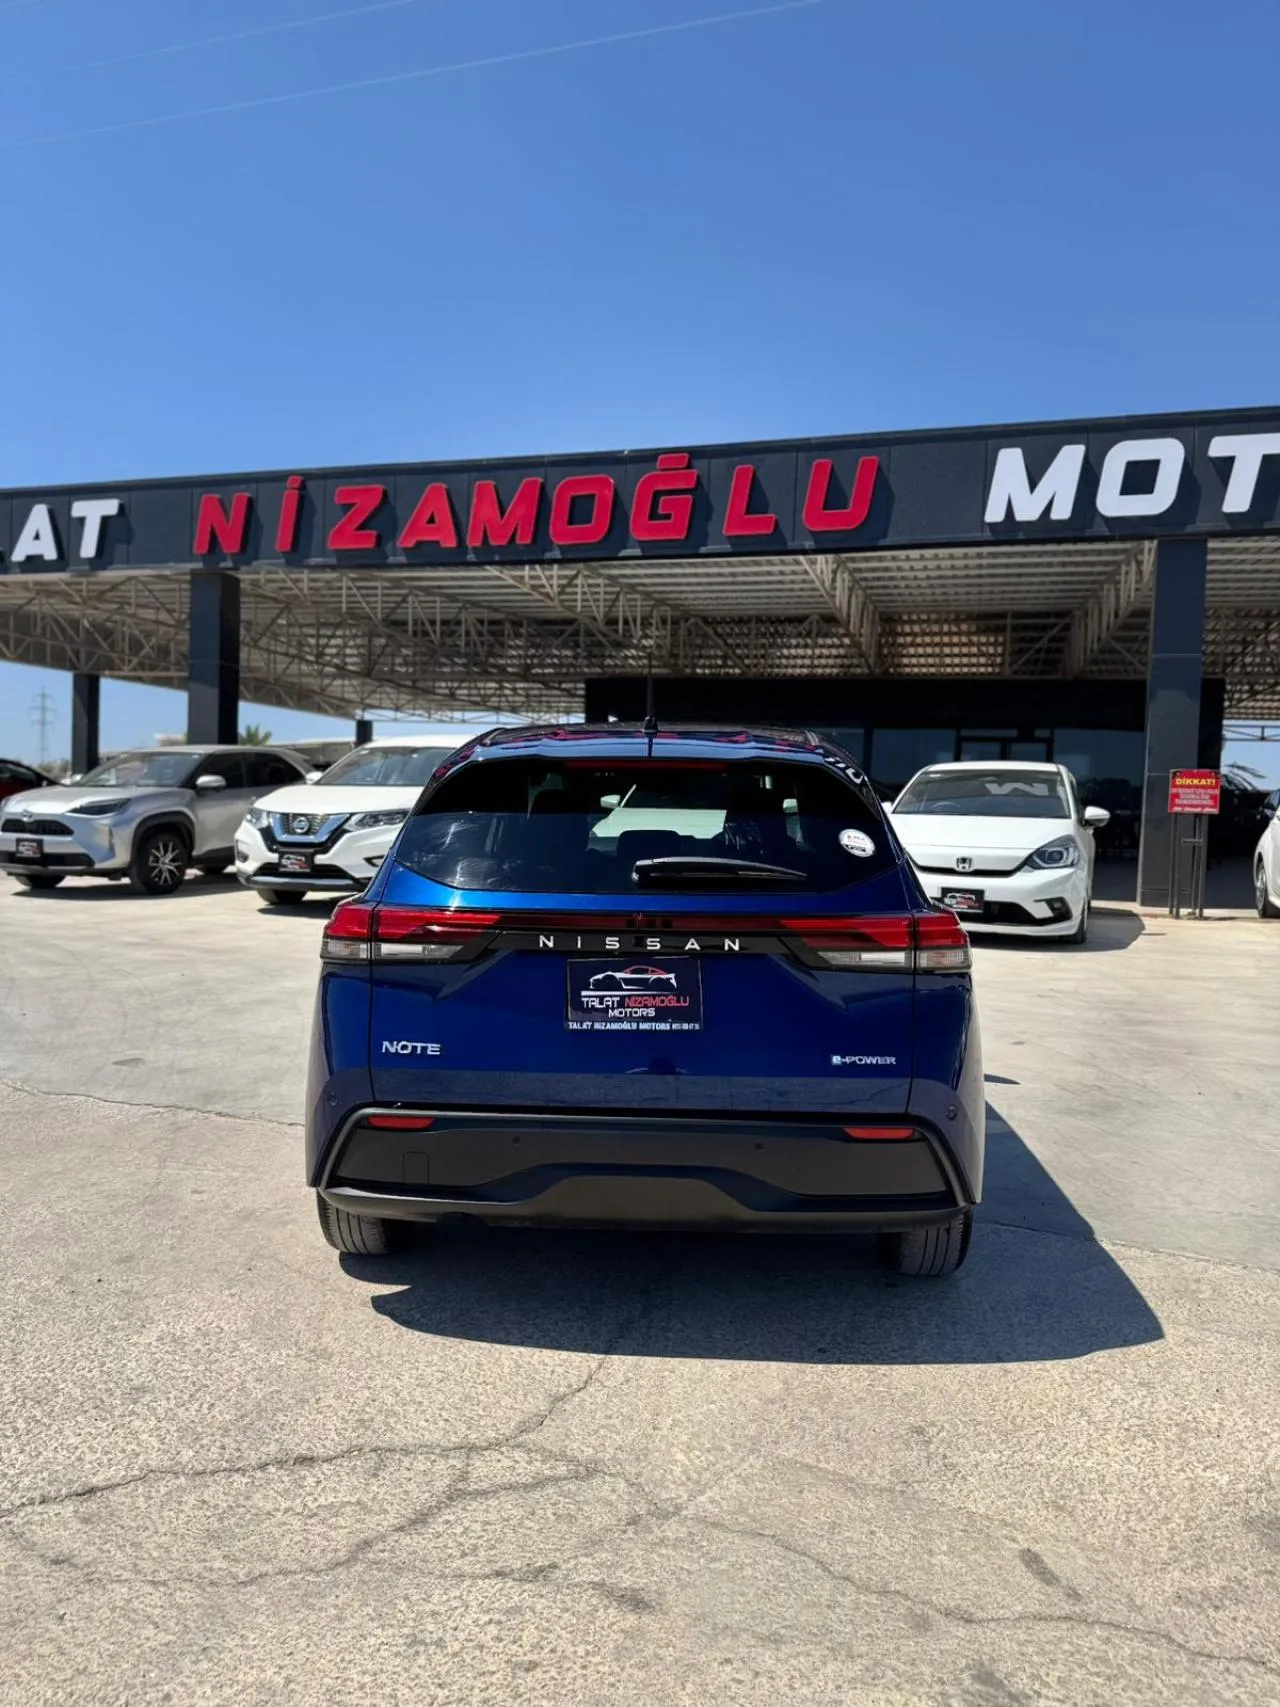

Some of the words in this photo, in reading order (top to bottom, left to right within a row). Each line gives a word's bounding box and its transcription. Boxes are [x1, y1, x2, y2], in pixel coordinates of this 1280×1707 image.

[193, 453, 879, 555] NİZAMOĞLU
[984, 433, 1280, 523] MOT
[539, 935, 740, 951] NISSAN
[581, 996, 620, 1008] TALAT
[608, 1008, 656, 1018] MOTORS
[568, 1021, 592, 1030] TALAT
[639, 1021, 671, 1030] MOTORS
[381, 1040, 441, 1055] NOTE
